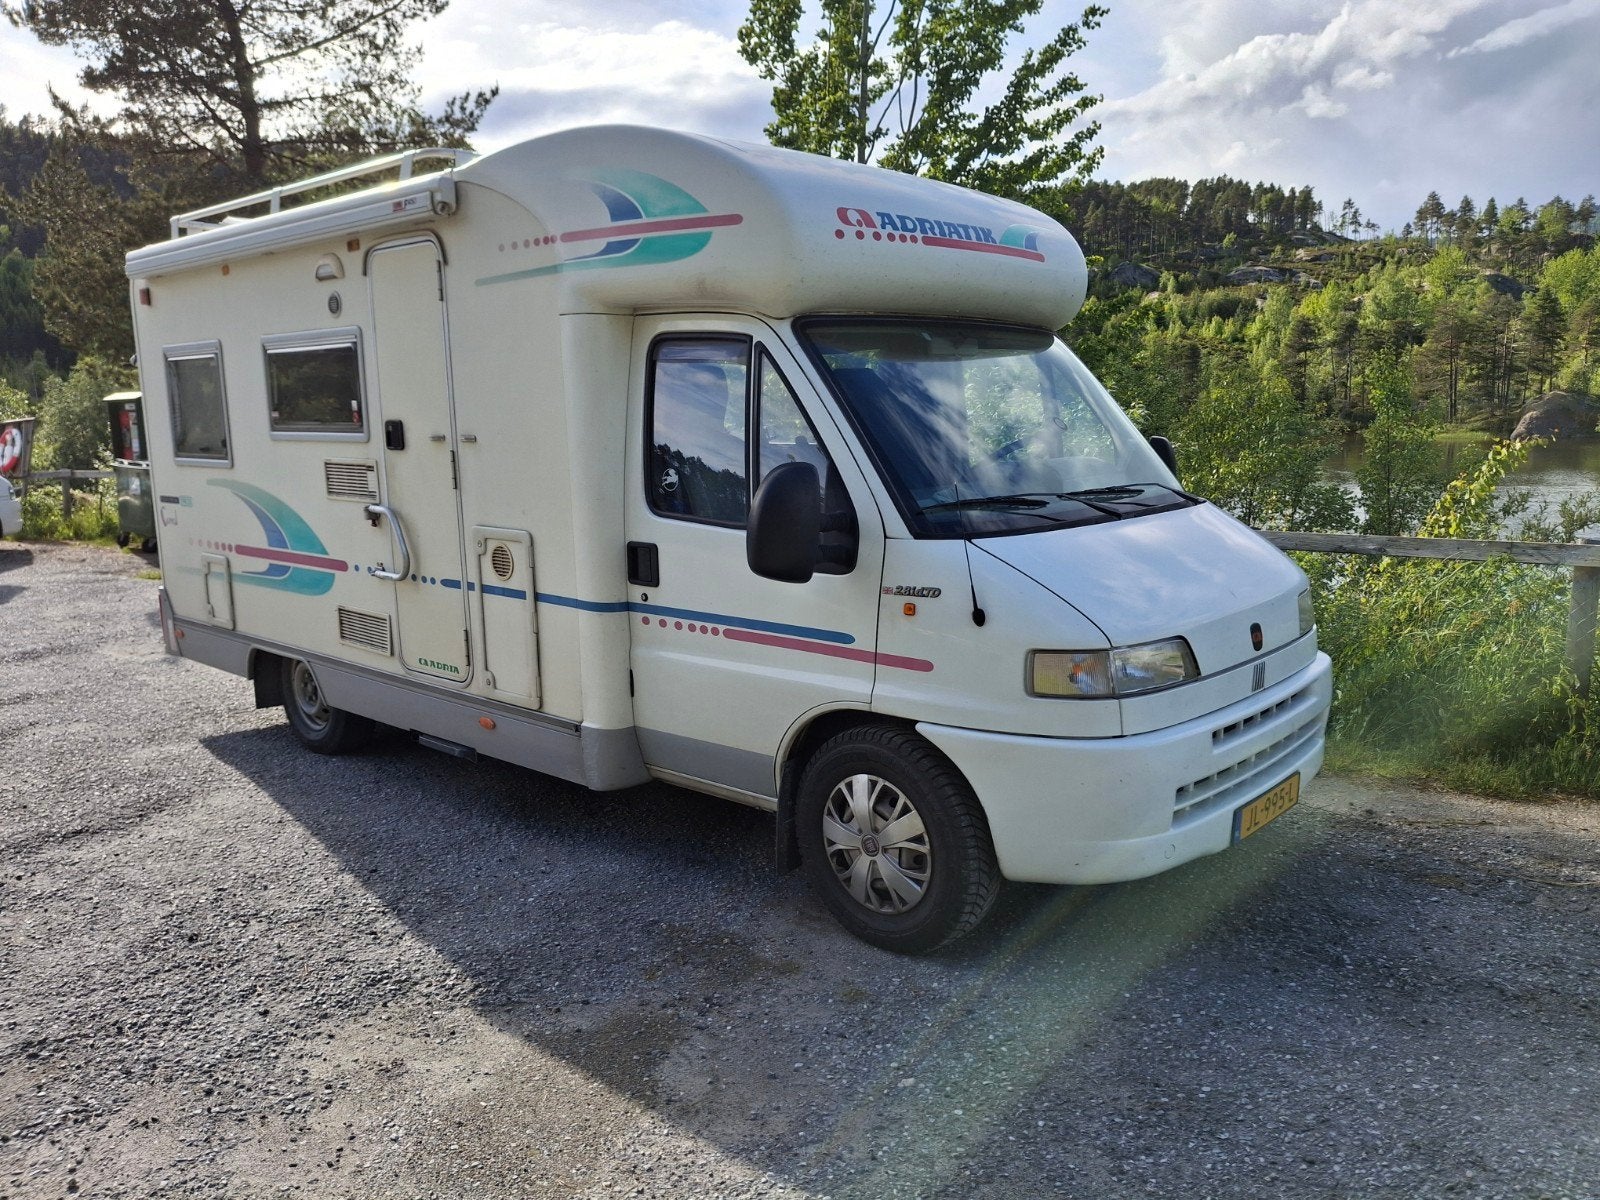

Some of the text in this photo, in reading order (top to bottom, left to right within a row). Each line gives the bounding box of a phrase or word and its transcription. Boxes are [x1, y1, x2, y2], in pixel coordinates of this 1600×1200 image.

[875, 211, 998, 245] ADRIATIK
[429, 659, 460, 675] ADRIA
[1246, 782, 1294, 832] JL-995-L
